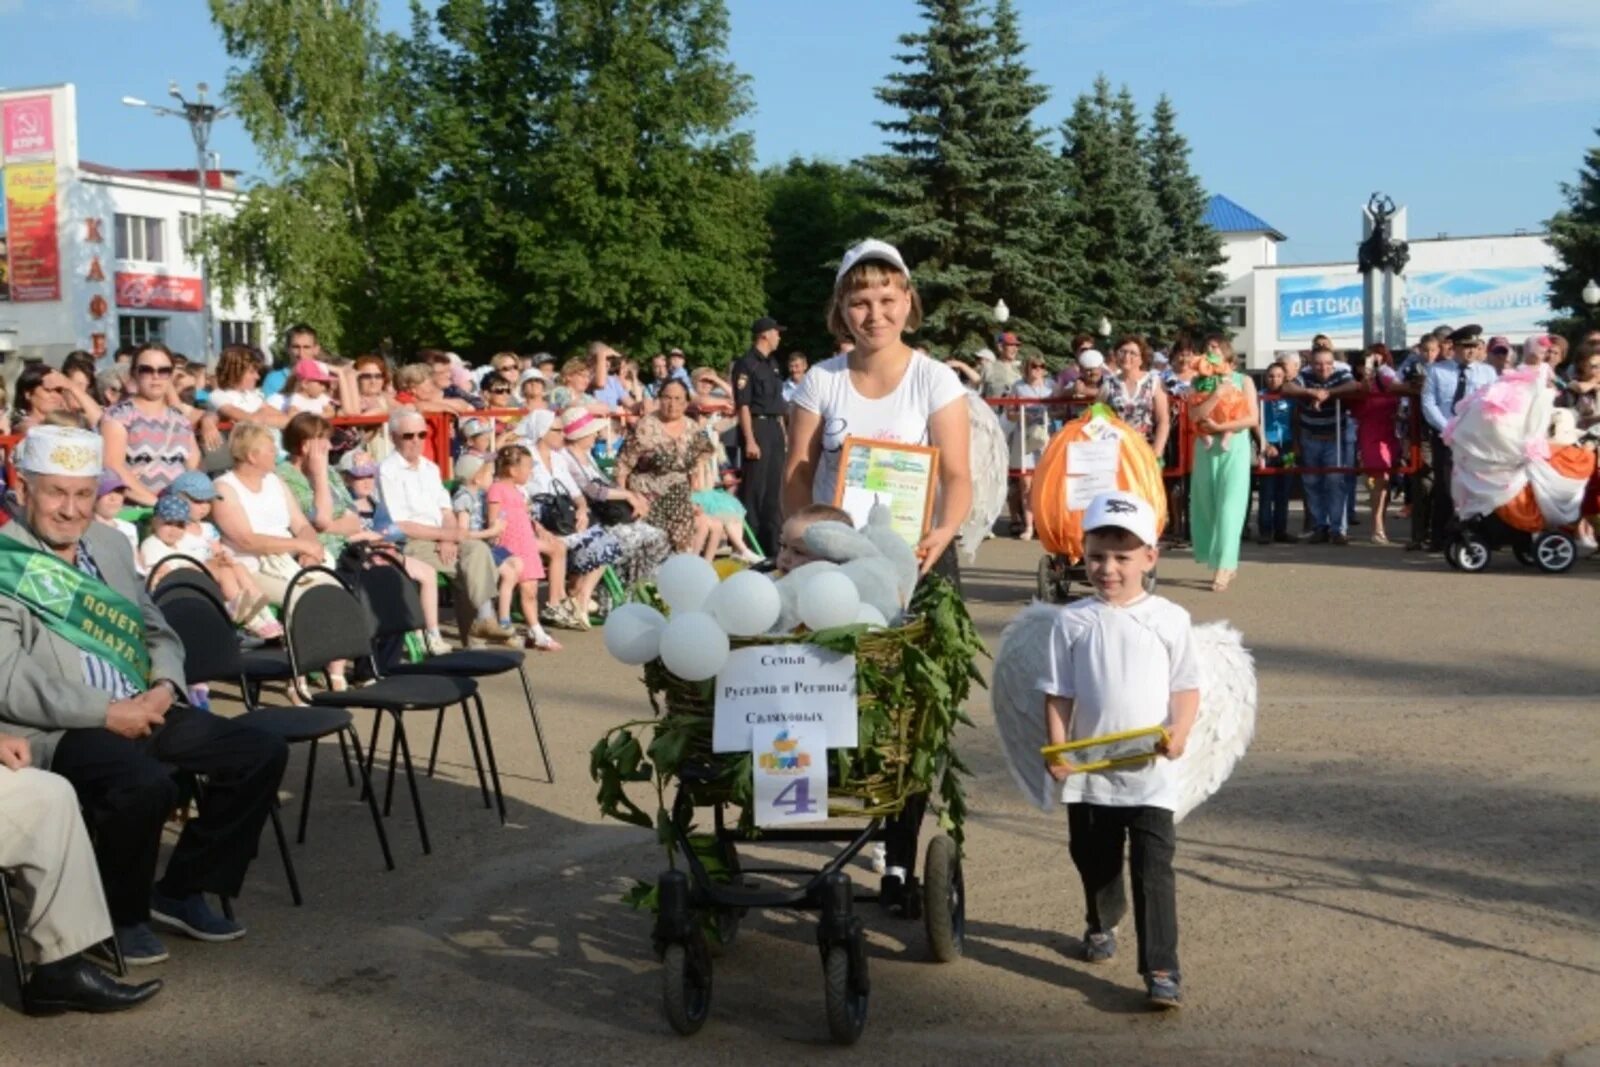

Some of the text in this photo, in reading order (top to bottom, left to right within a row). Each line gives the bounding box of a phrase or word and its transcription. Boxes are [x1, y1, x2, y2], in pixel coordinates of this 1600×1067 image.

[85, 217, 108, 358] КАФЕ
[1289, 295, 1363, 318] ДЕТСКА
[724, 681, 848, 701] Рустама и Регины
[771, 777, 818, 816] 4
